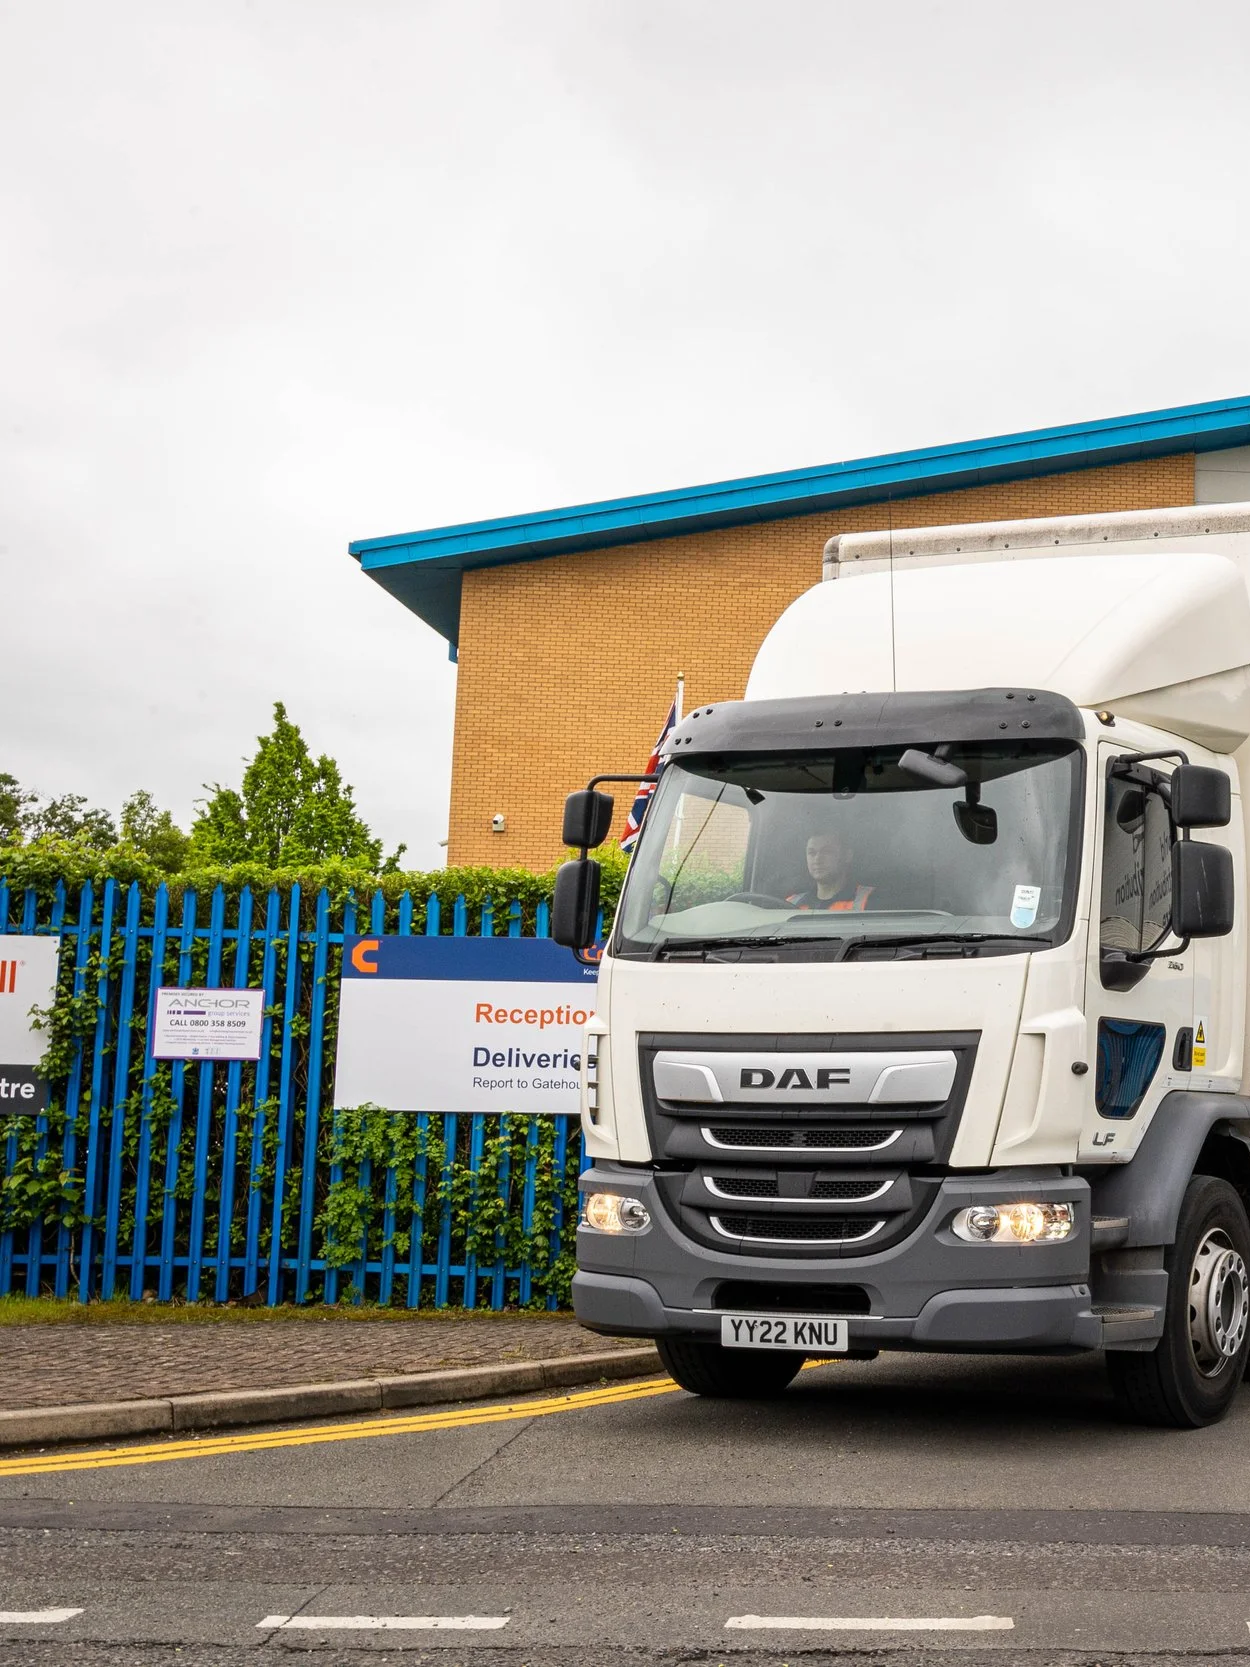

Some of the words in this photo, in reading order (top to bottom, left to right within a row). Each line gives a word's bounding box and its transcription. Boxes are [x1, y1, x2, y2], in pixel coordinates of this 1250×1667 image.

[189, 1019, 208, 1027] 0800
[475, 1003, 596, 1029] Receptio
[473, 1077, 513, 1090] Report
[517, 1078, 528, 1089] to
[740, 1068, 851, 1090] DAF
[1092, 1132, 1116, 1147] LF
[730, 1319, 787, 1345] YY22
[793, 1321, 838, 1346] KNU
